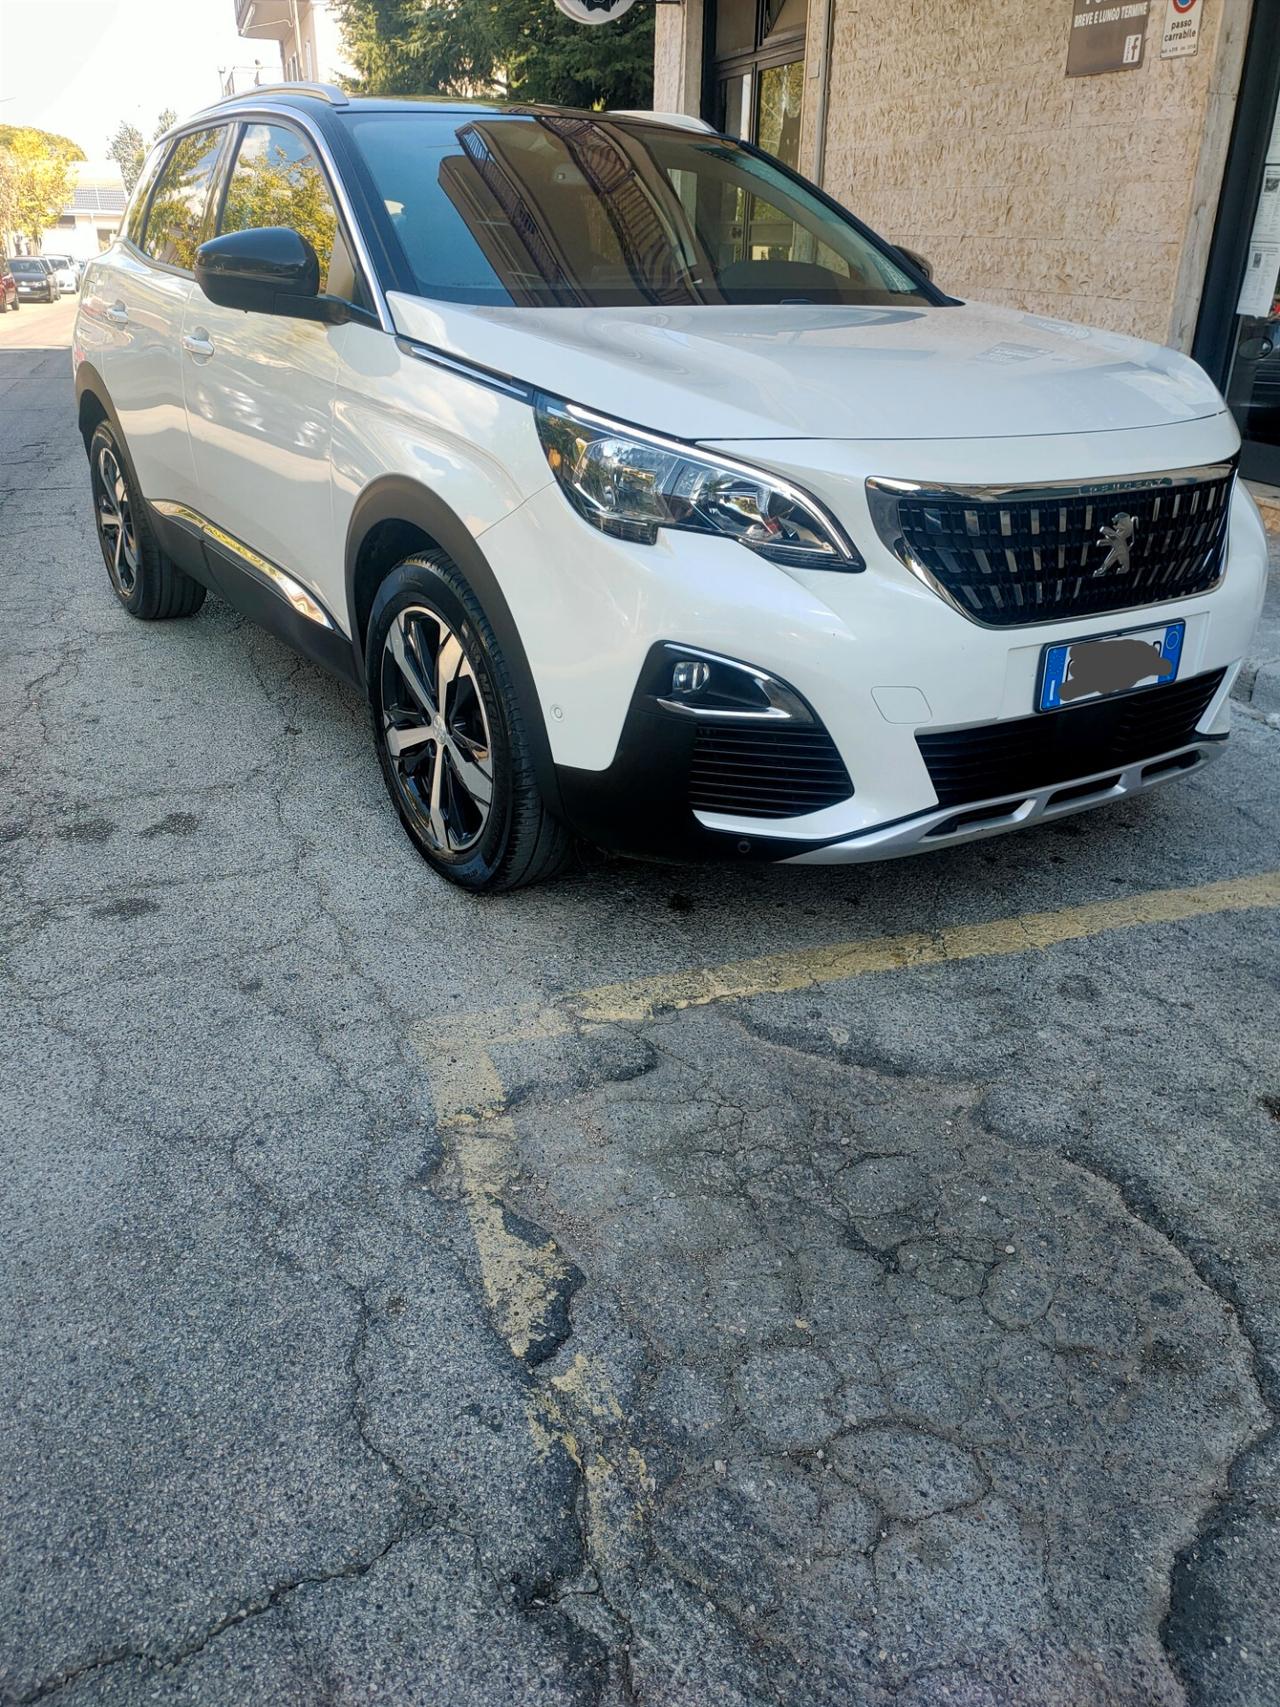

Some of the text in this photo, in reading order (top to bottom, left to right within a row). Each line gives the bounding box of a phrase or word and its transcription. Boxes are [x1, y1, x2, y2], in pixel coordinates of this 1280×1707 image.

[1099, 7, 1121, 23] LUNGO
[1121, 2, 1149, 19] TERMINE
[1171, 19, 1192, 31] passo
[1164, 29, 1196, 42] carrabile
